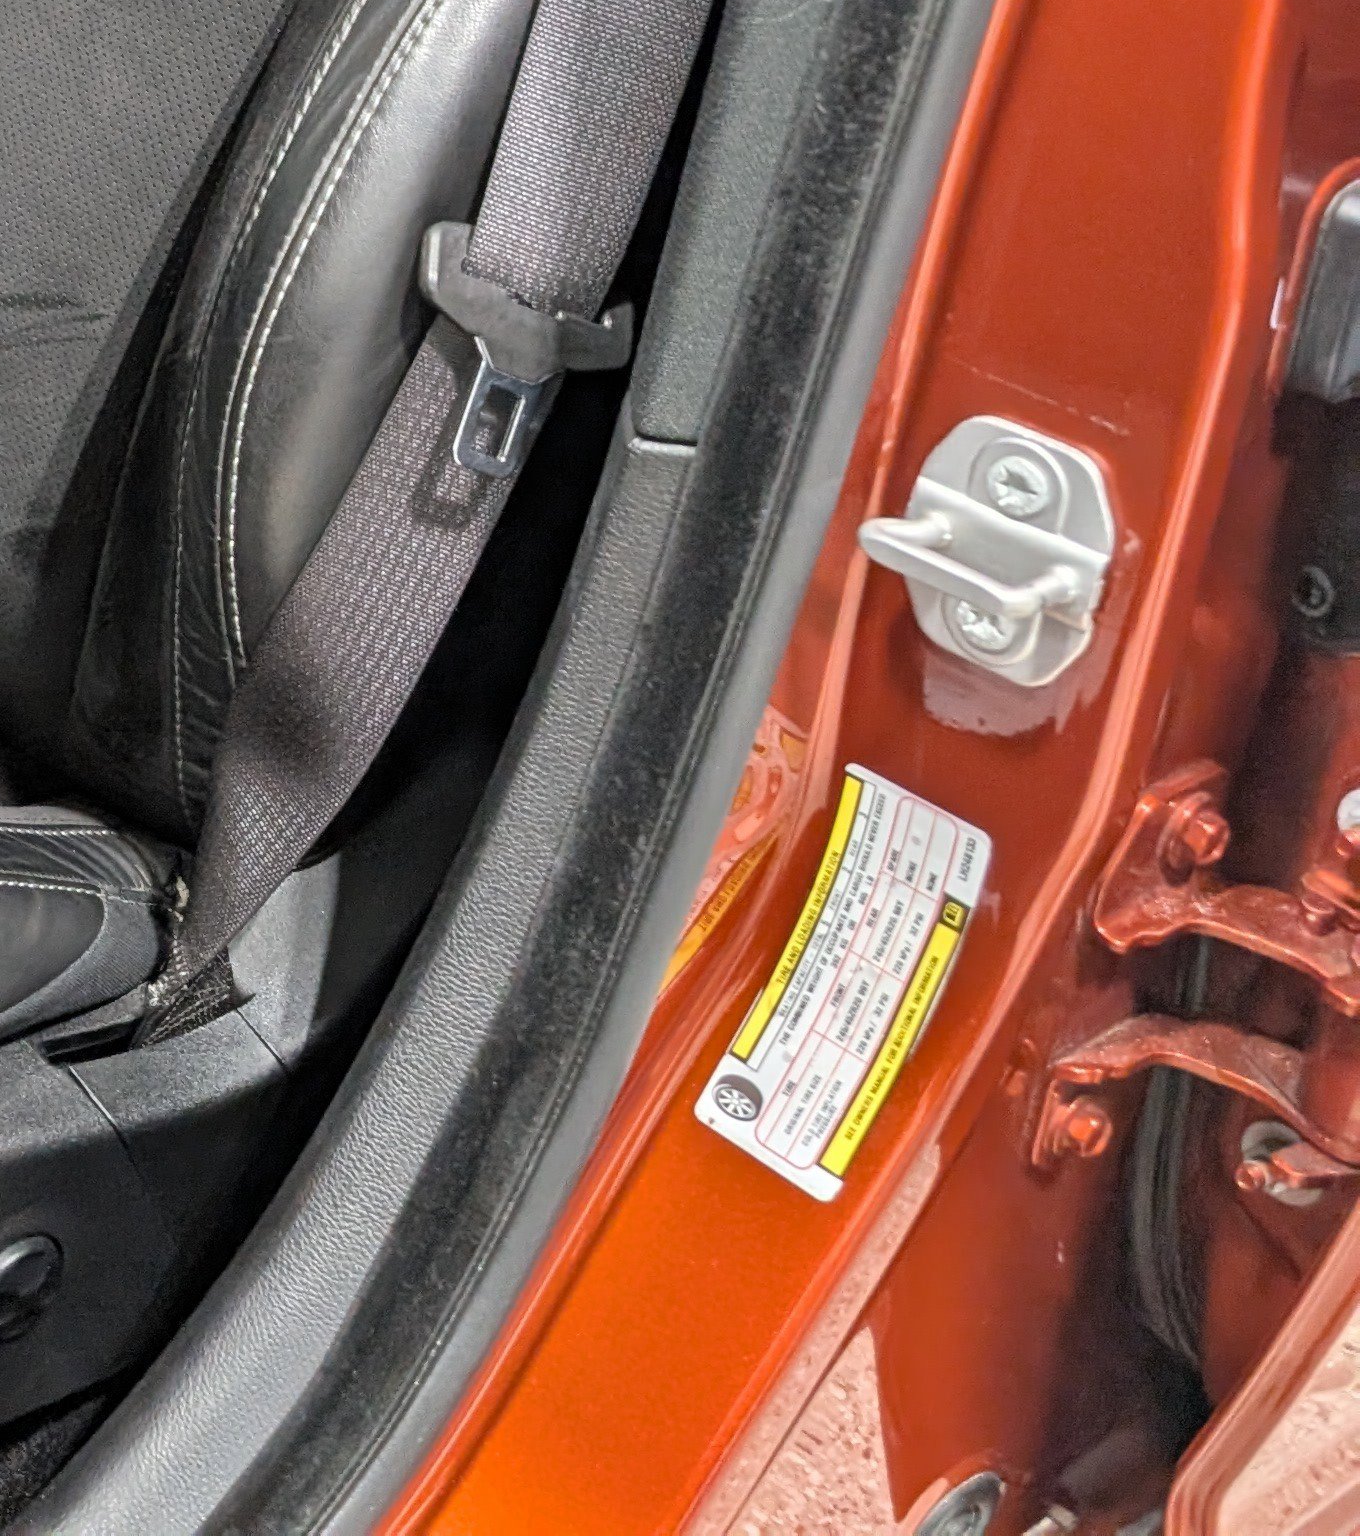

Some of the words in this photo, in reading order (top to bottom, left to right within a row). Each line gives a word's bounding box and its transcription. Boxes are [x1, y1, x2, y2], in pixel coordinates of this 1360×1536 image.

[866, 817, 879, 844] NEVER
[848, 869, 863, 898] CARGO
[775, 963, 791, 986] TIRE
[785, 943, 801, 965] AND
[794, 904, 817, 947] LOADING
[810, 848, 839, 908] INFORMATION
[841, 894, 853, 913] AND
[823, 910, 846, 956] OCCUPANTS
[818, 954, 829, 967] OF
[829, 981, 846, 1008] FRONT
[865, 905, 878, 929] REAR
[805, 965, 824, 995] WEIGHT
[786, 992, 810, 1032] COMBINED
[778, 1030, 791, 1046] THE
[843, 1125, 856, 1141] SEE
[869, 1063, 889, 1096] MANUAL
[885, 1046, 898, 1064] FOR
[892, 1005, 917, 1048] ADDITIONAL
[911, 953, 939, 1005] INFORMATION
